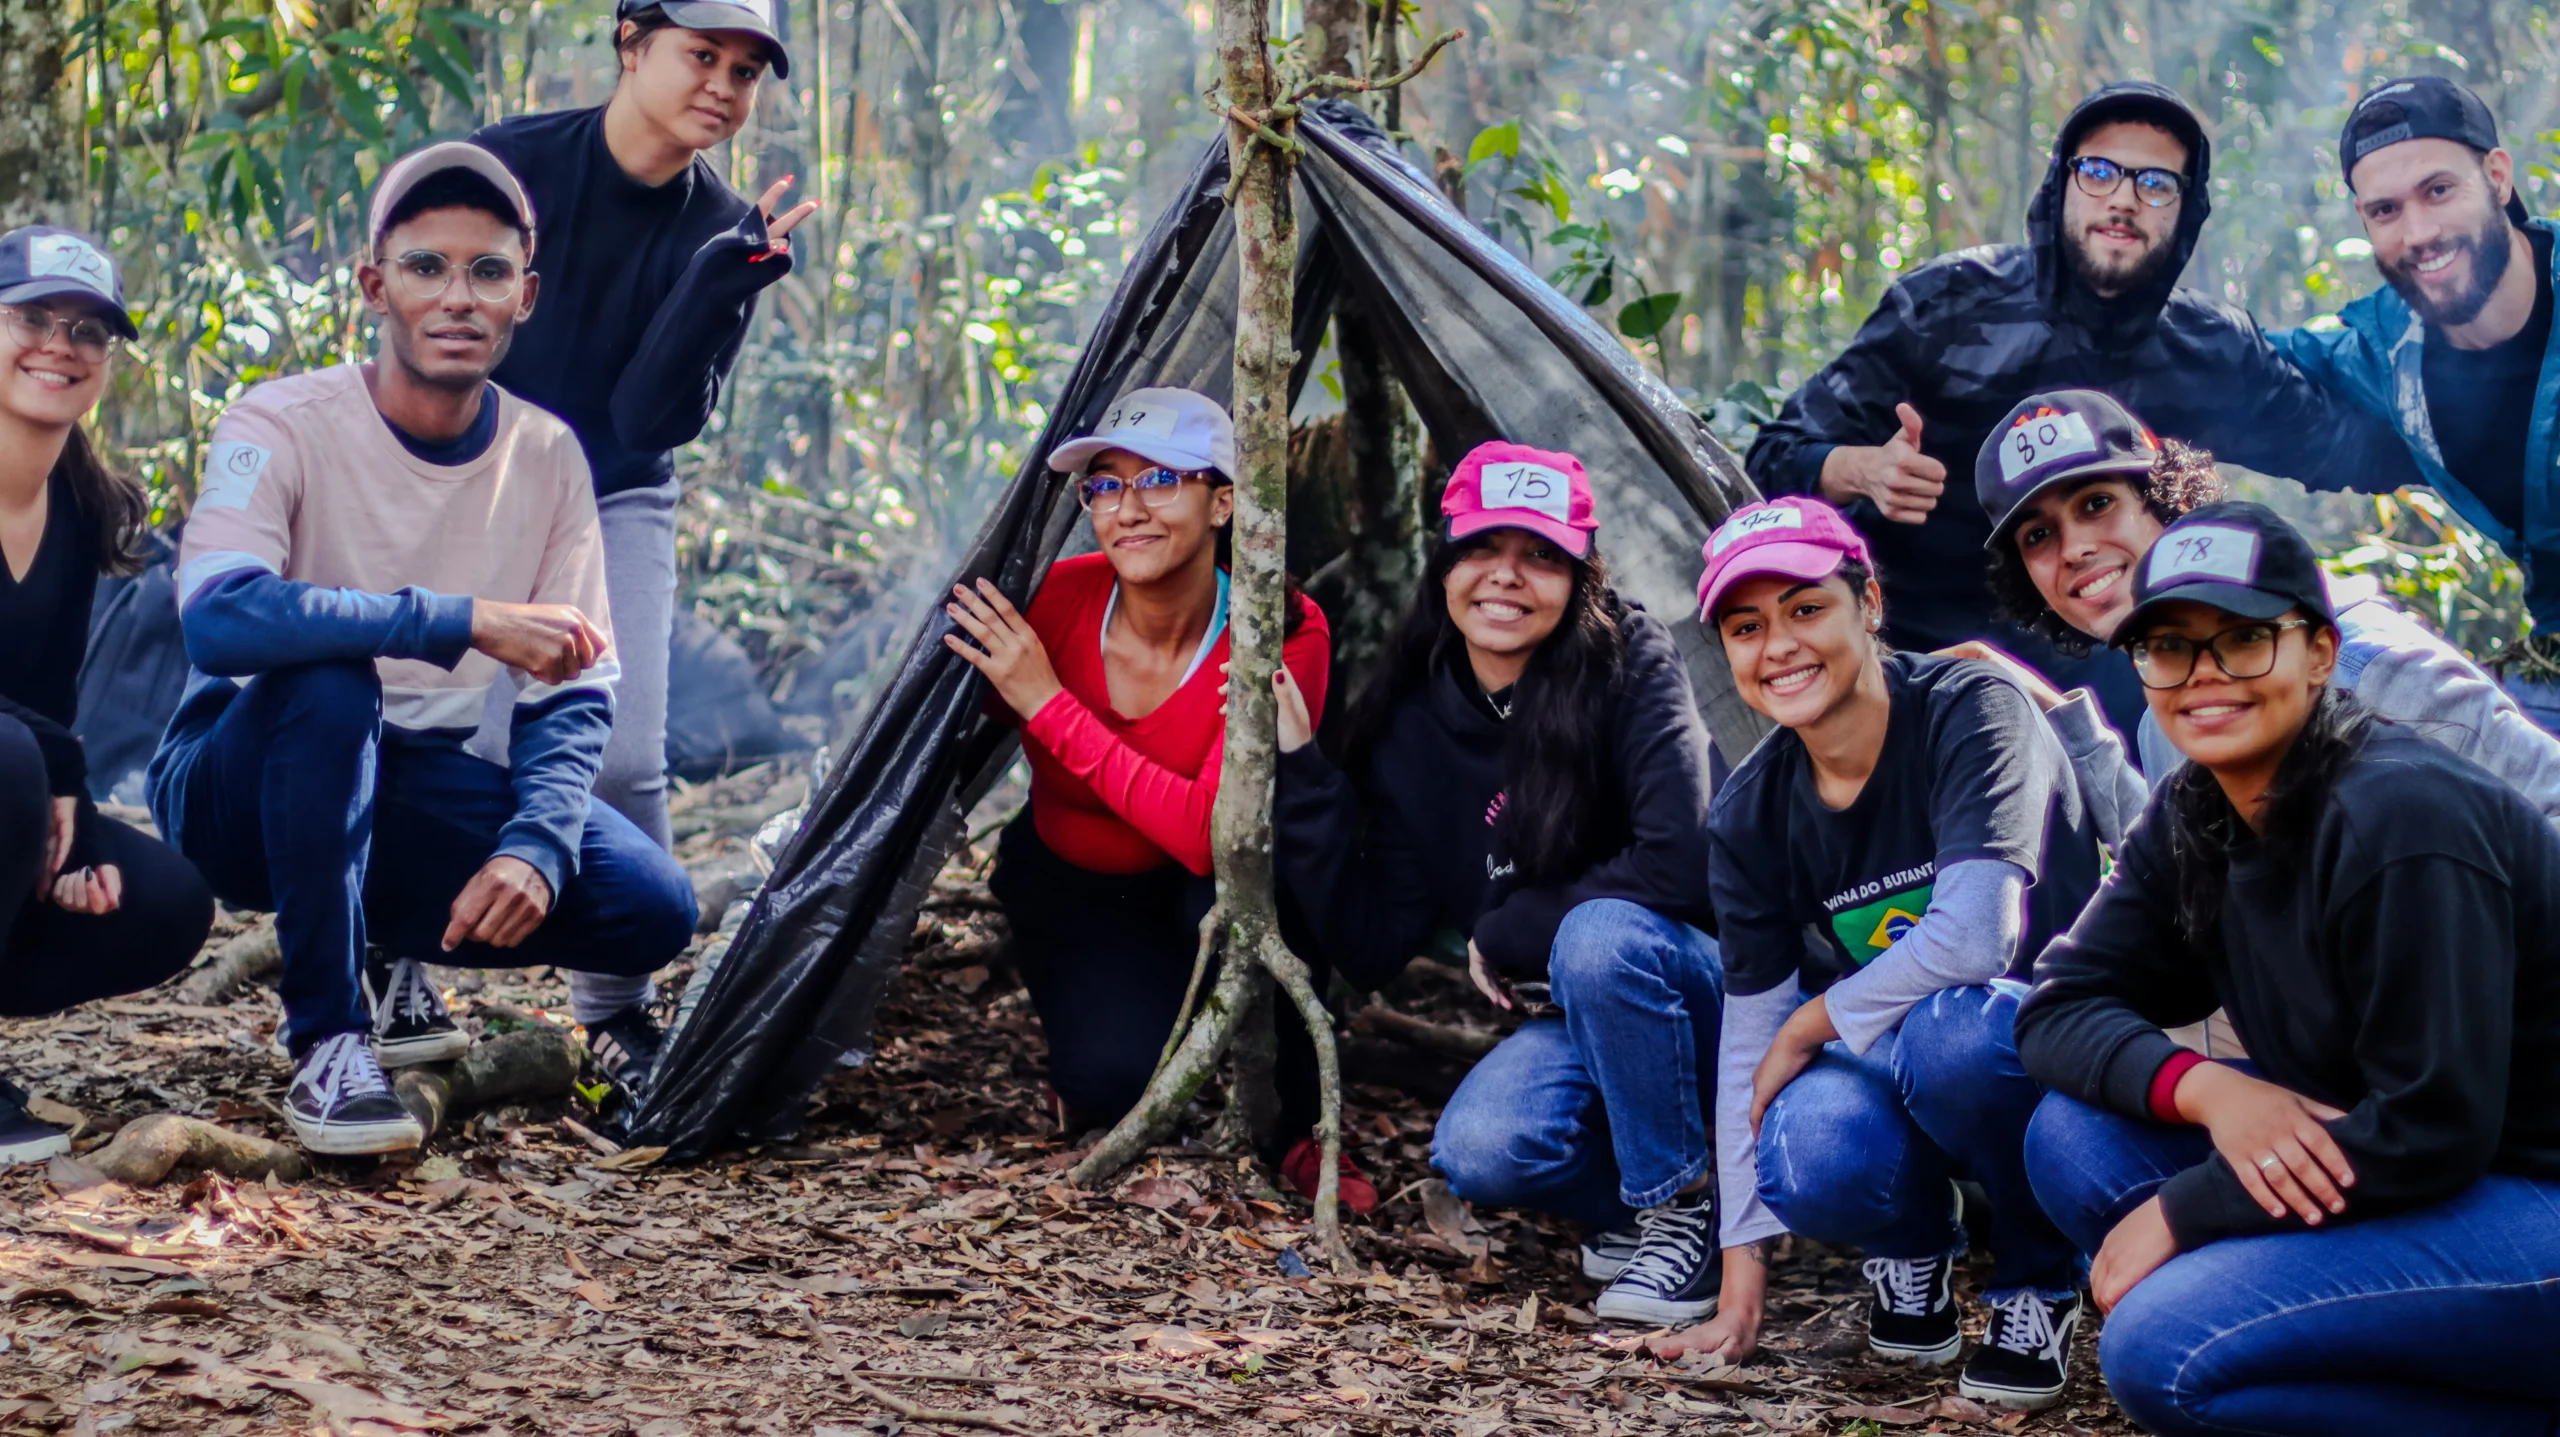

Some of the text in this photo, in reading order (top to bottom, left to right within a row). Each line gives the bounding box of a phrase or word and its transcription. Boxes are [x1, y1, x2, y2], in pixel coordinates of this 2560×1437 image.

[56, 245, 105, 282] 72
[1110, 409, 1146, 428] 79
[2016, 423, 2058, 465] 80
[1505, 467, 1551, 499] 75
[2173, 536, 2214, 568] 78
[1859, 881, 1881, 899] DO
[1882, 861, 1936, 890] BUTANT
